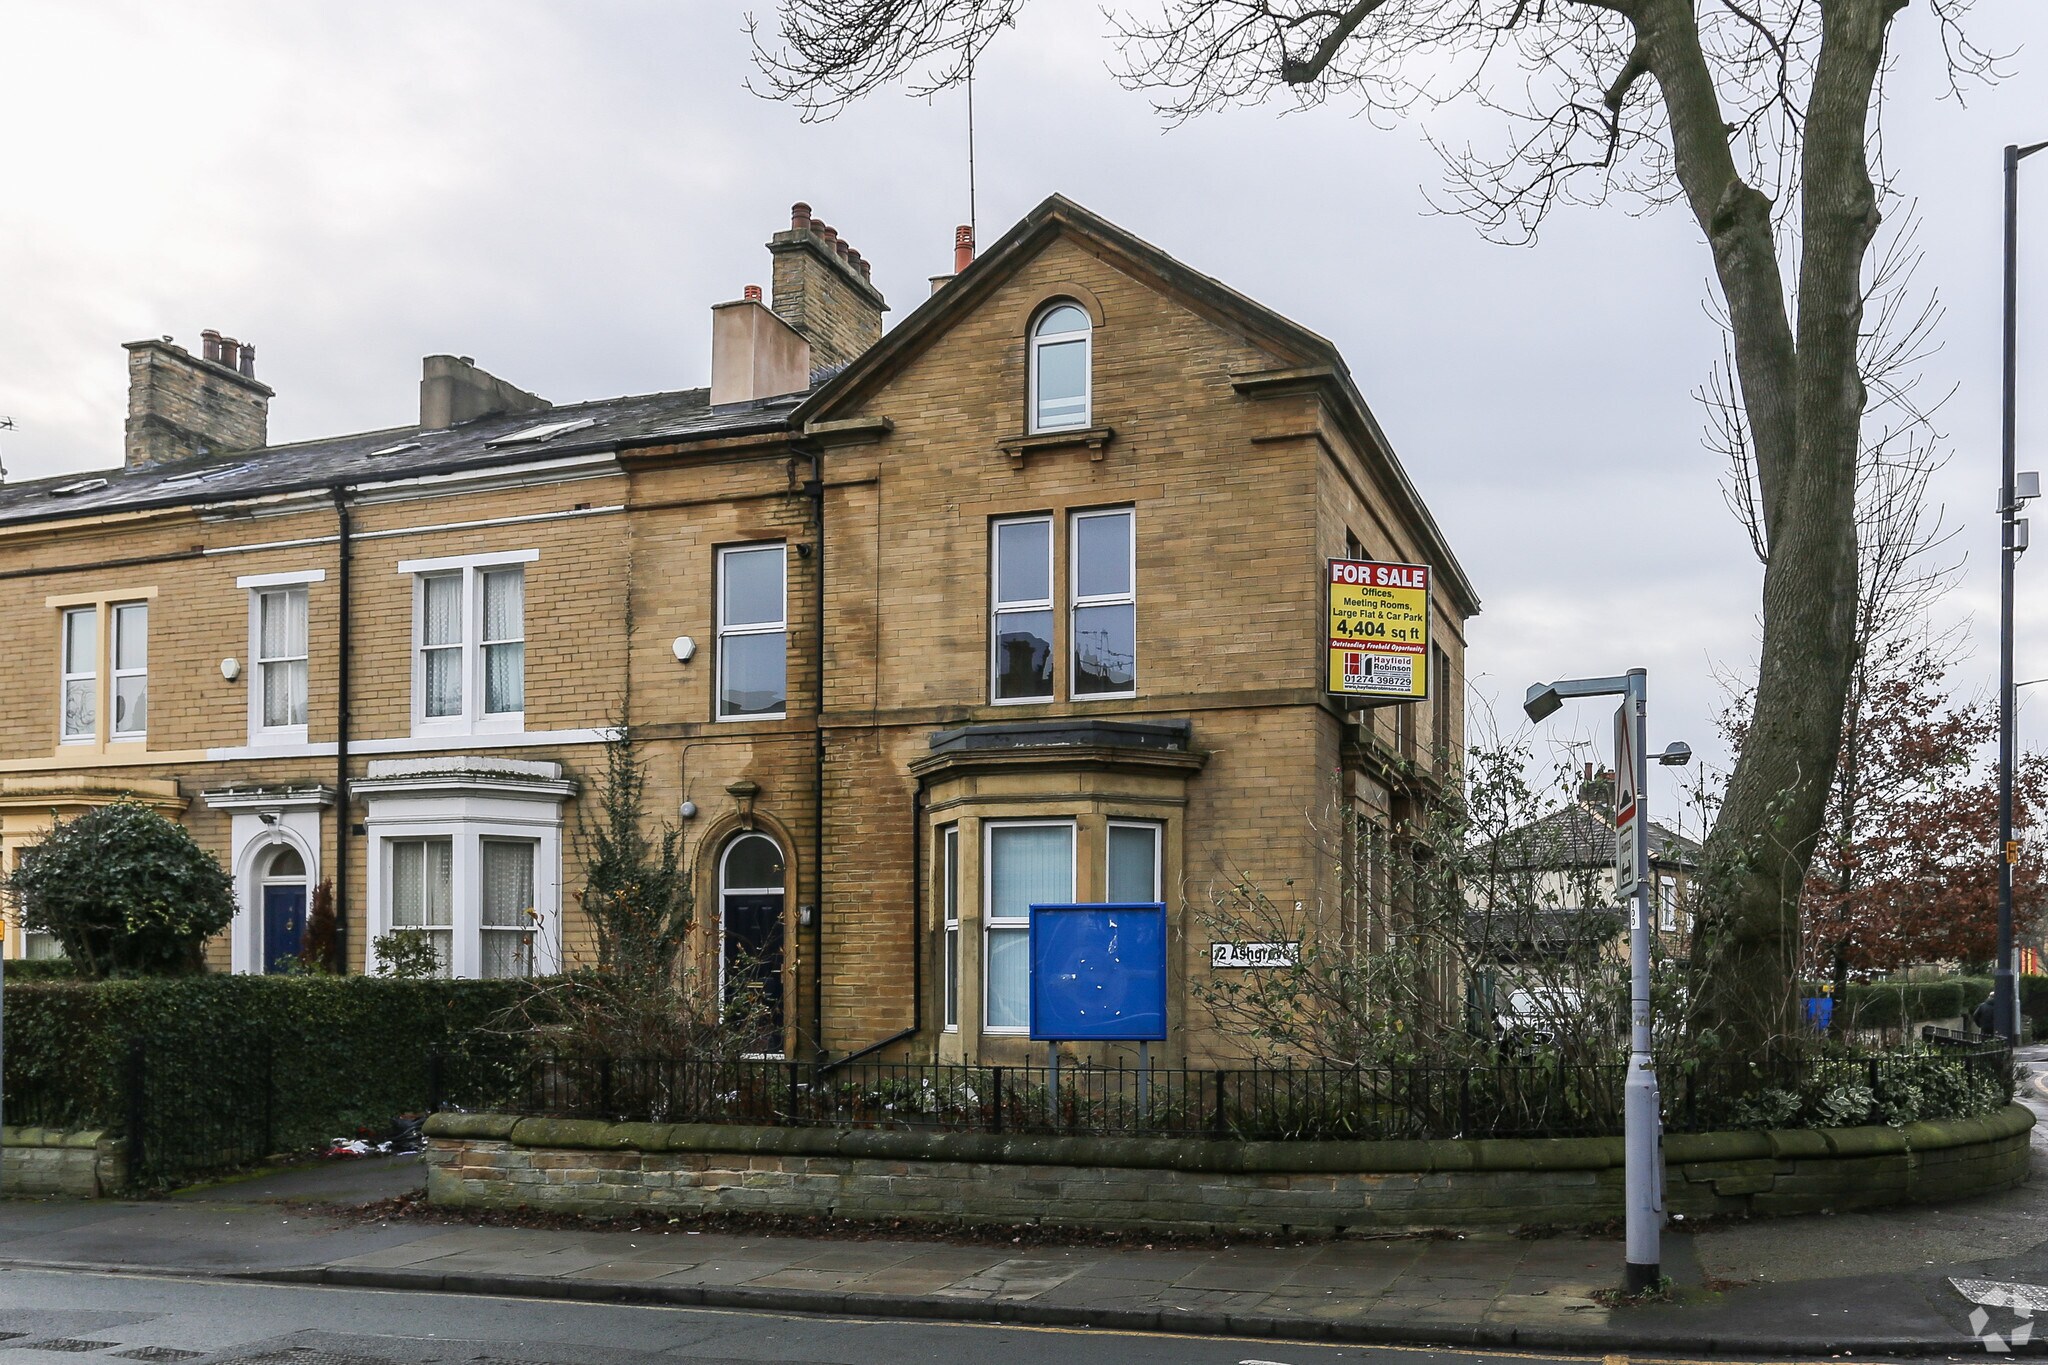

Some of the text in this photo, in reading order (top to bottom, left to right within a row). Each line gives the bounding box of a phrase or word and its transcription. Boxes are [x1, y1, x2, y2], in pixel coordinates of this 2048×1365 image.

[1333, 564, 1424, 588] FOR SALE
[1362, 587, 1394, 599] Offices,
[1343, 597, 1412, 611] Meeting Rooms,
[1333, 608, 1423, 621] Large Flat & Car Park
[1337, 619, 1419, 641] 4,404 sq ft
[1332, 640, 1424, 653] Outstanding Freehold Opportunity
[1373, 656, 1411, 665] Hayfield
[1373, 664, 1411, 672] Robinson
[1344, 675, 1411, 686] 01274 398729
[1230, 946, 1290, 963] Ashgrve
